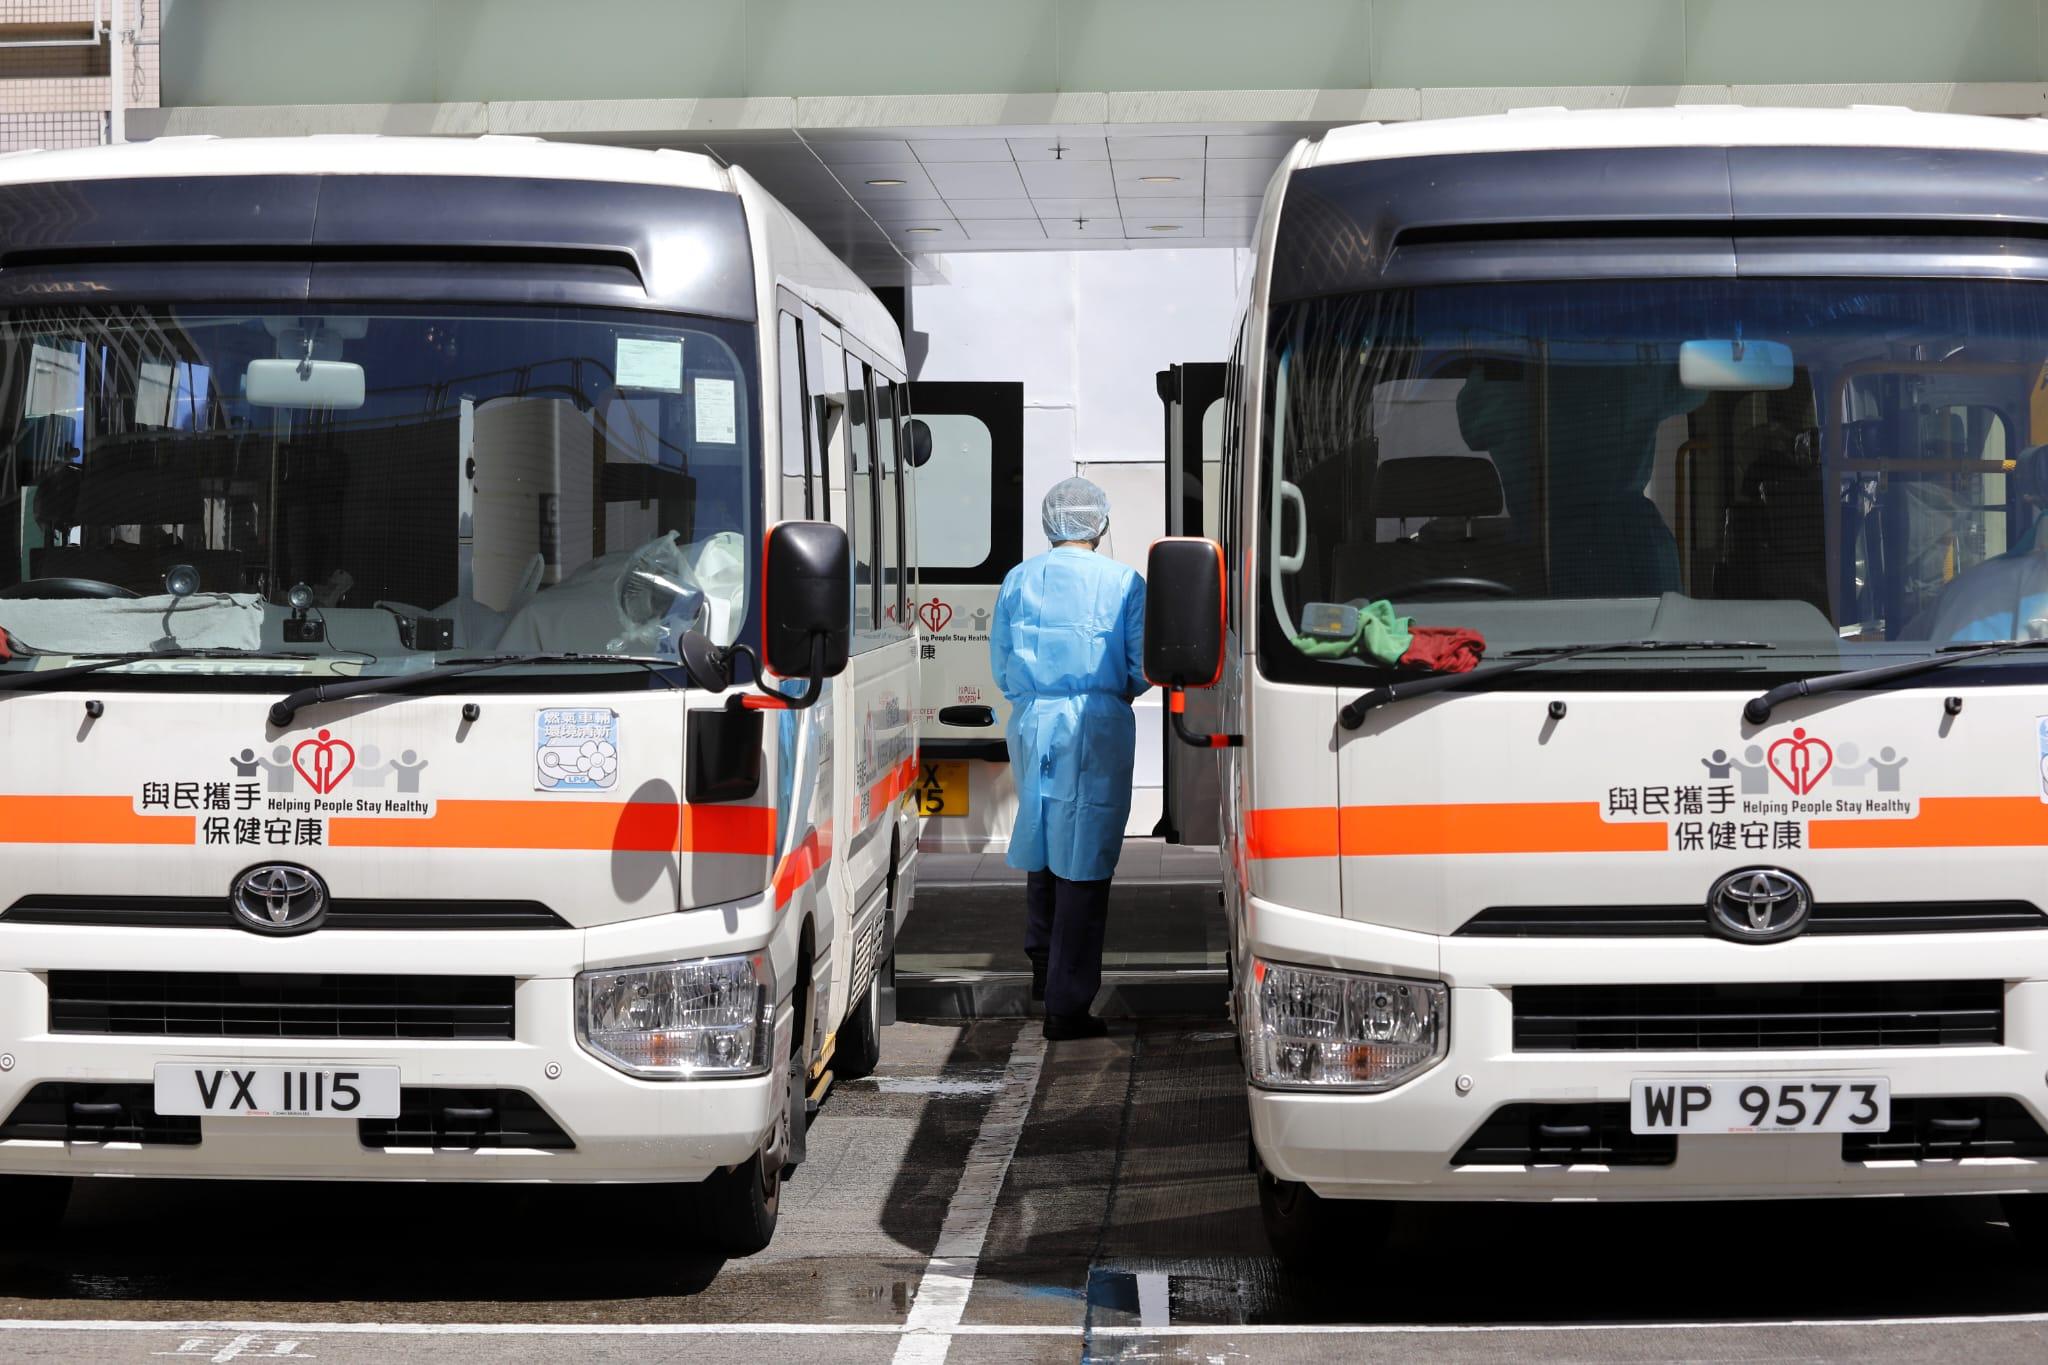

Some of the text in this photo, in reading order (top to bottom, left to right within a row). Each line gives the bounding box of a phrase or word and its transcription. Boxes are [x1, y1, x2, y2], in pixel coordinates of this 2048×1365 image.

[922, 764, 940, 788] X
[142, 781, 261, 811] 與民攜手
[268, 798, 429, 815] Helping People Stay Healthy
[1608, 785, 1735, 816] 與民攜手
[1743, 799, 1910, 815] Helping People Stay Healthy
[202, 816, 323, 846] 保健安康
[1675, 820, 1802, 851] 保健安康
[195, 1070, 362, 1112] VX 1115
[1645, 1083, 1879, 1127] WP 9573
